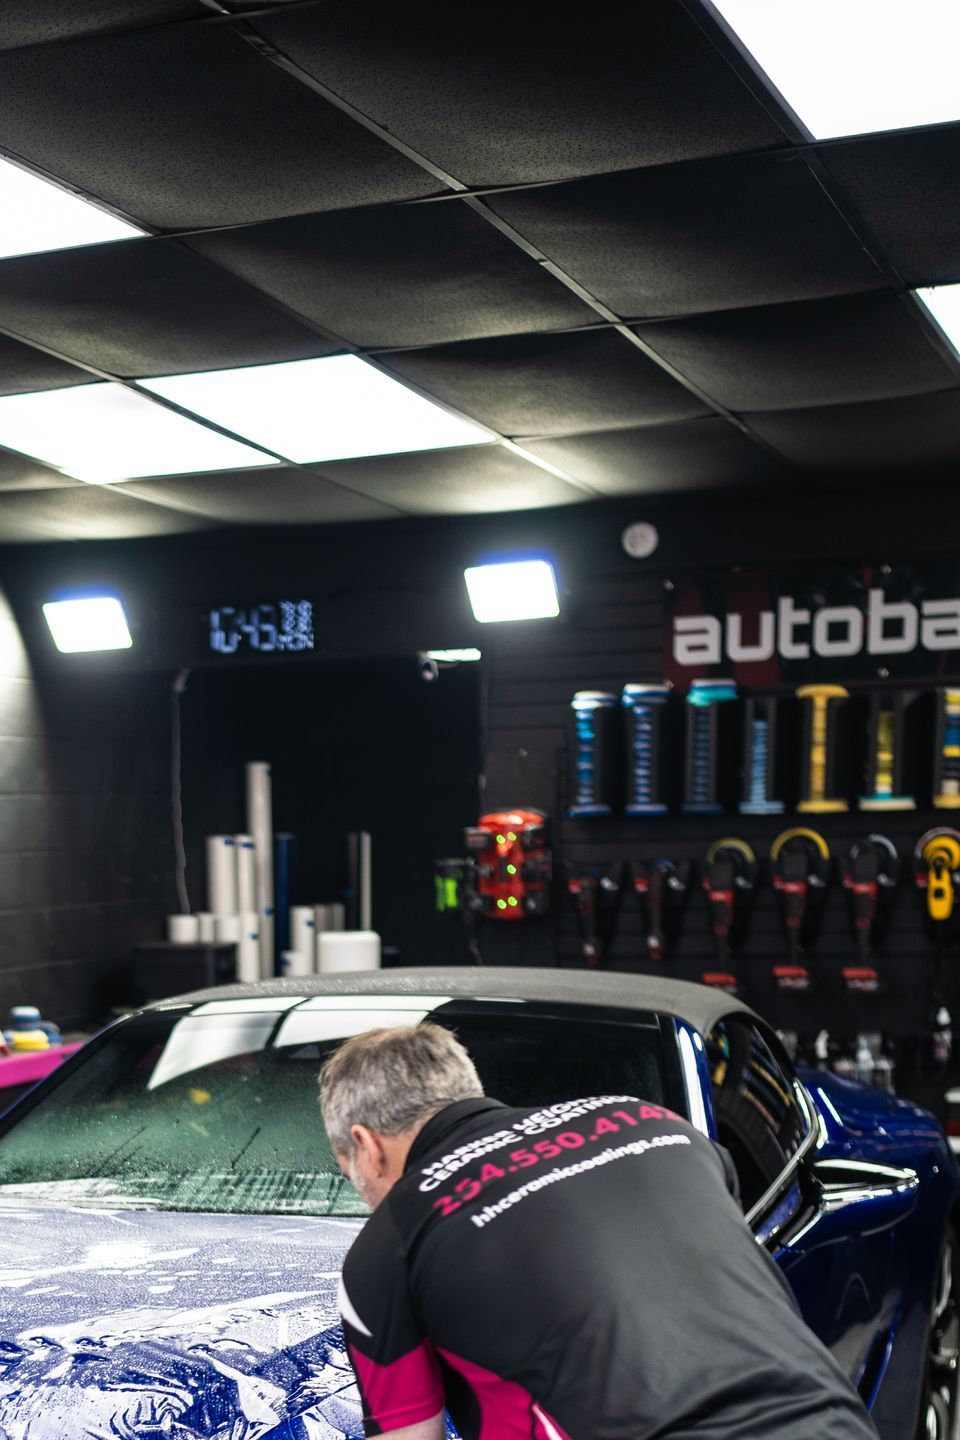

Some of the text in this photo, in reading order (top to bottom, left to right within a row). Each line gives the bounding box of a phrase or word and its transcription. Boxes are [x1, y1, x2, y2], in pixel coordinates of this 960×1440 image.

[673, 588, 960, 666] autoba
[419, 1133, 524, 1192] CERAMIC
[471, 1134, 691, 1227] hhceramiccoatings.com
